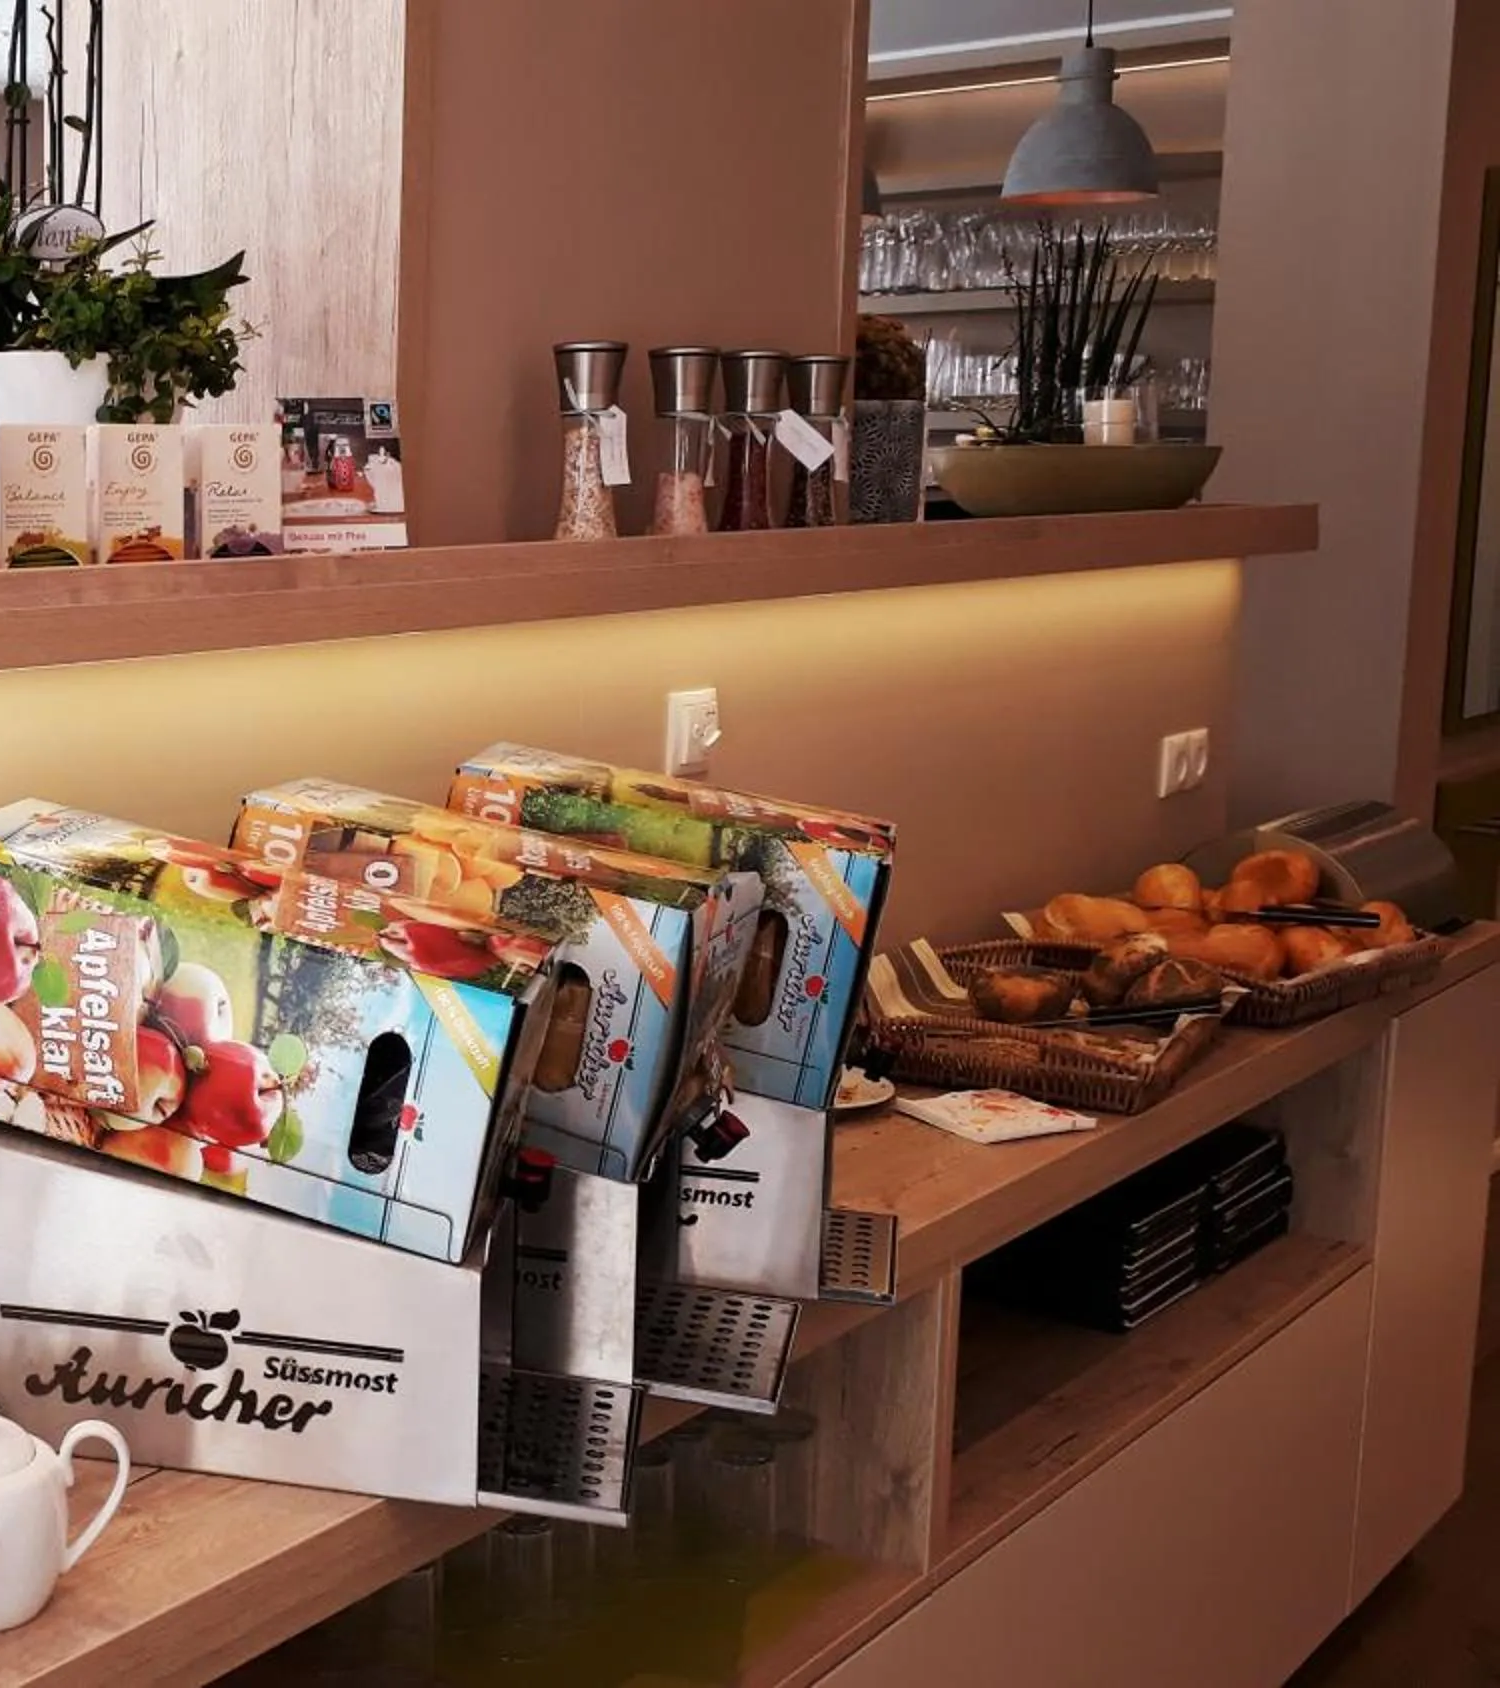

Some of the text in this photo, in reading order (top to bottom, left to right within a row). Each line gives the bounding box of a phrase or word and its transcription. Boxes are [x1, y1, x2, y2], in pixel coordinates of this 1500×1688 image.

[27, 431, 58, 443] GEPA
[127, 432, 156, 444] GEPA
[229, 431, 257, 443] GEPA
[480, 789, 516, 824] 10
[263, 824, 303, 865] 10
[71, 928, 125, 1105] Apfelsaft
[41, 1006, 77, 1080] klar
[680, 1186, 755, 1209] smost
[518, 1270, 564, 1291] ost
[24, 1345, 333, 1433] Auricher
[262, 1355, 399, 1394] Süssmost
